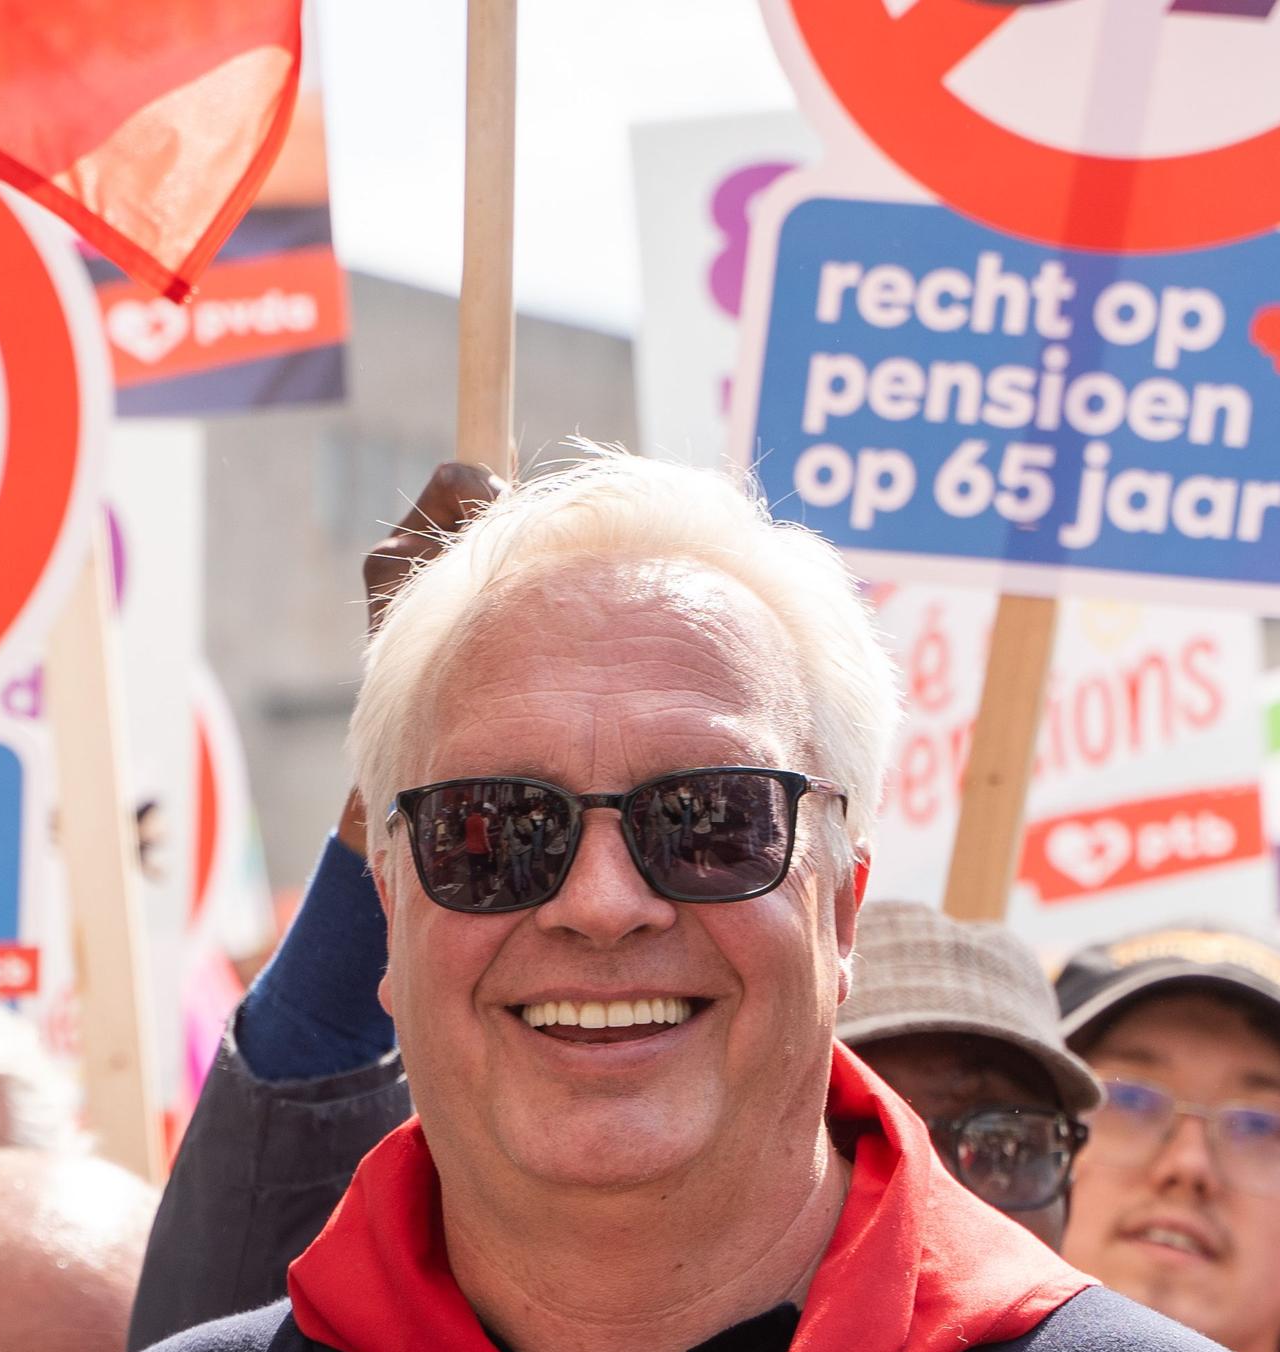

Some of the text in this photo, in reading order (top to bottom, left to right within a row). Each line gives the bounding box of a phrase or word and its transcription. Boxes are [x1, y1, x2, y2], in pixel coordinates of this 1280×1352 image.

[813, 251, 1227, 369] recht op
[801, 348, 1252, 450] pensioen
[792, 443, 917, 530] op
[933, 439, 1056, 520] 65
[1136, 811, 1236, 873] ptb
